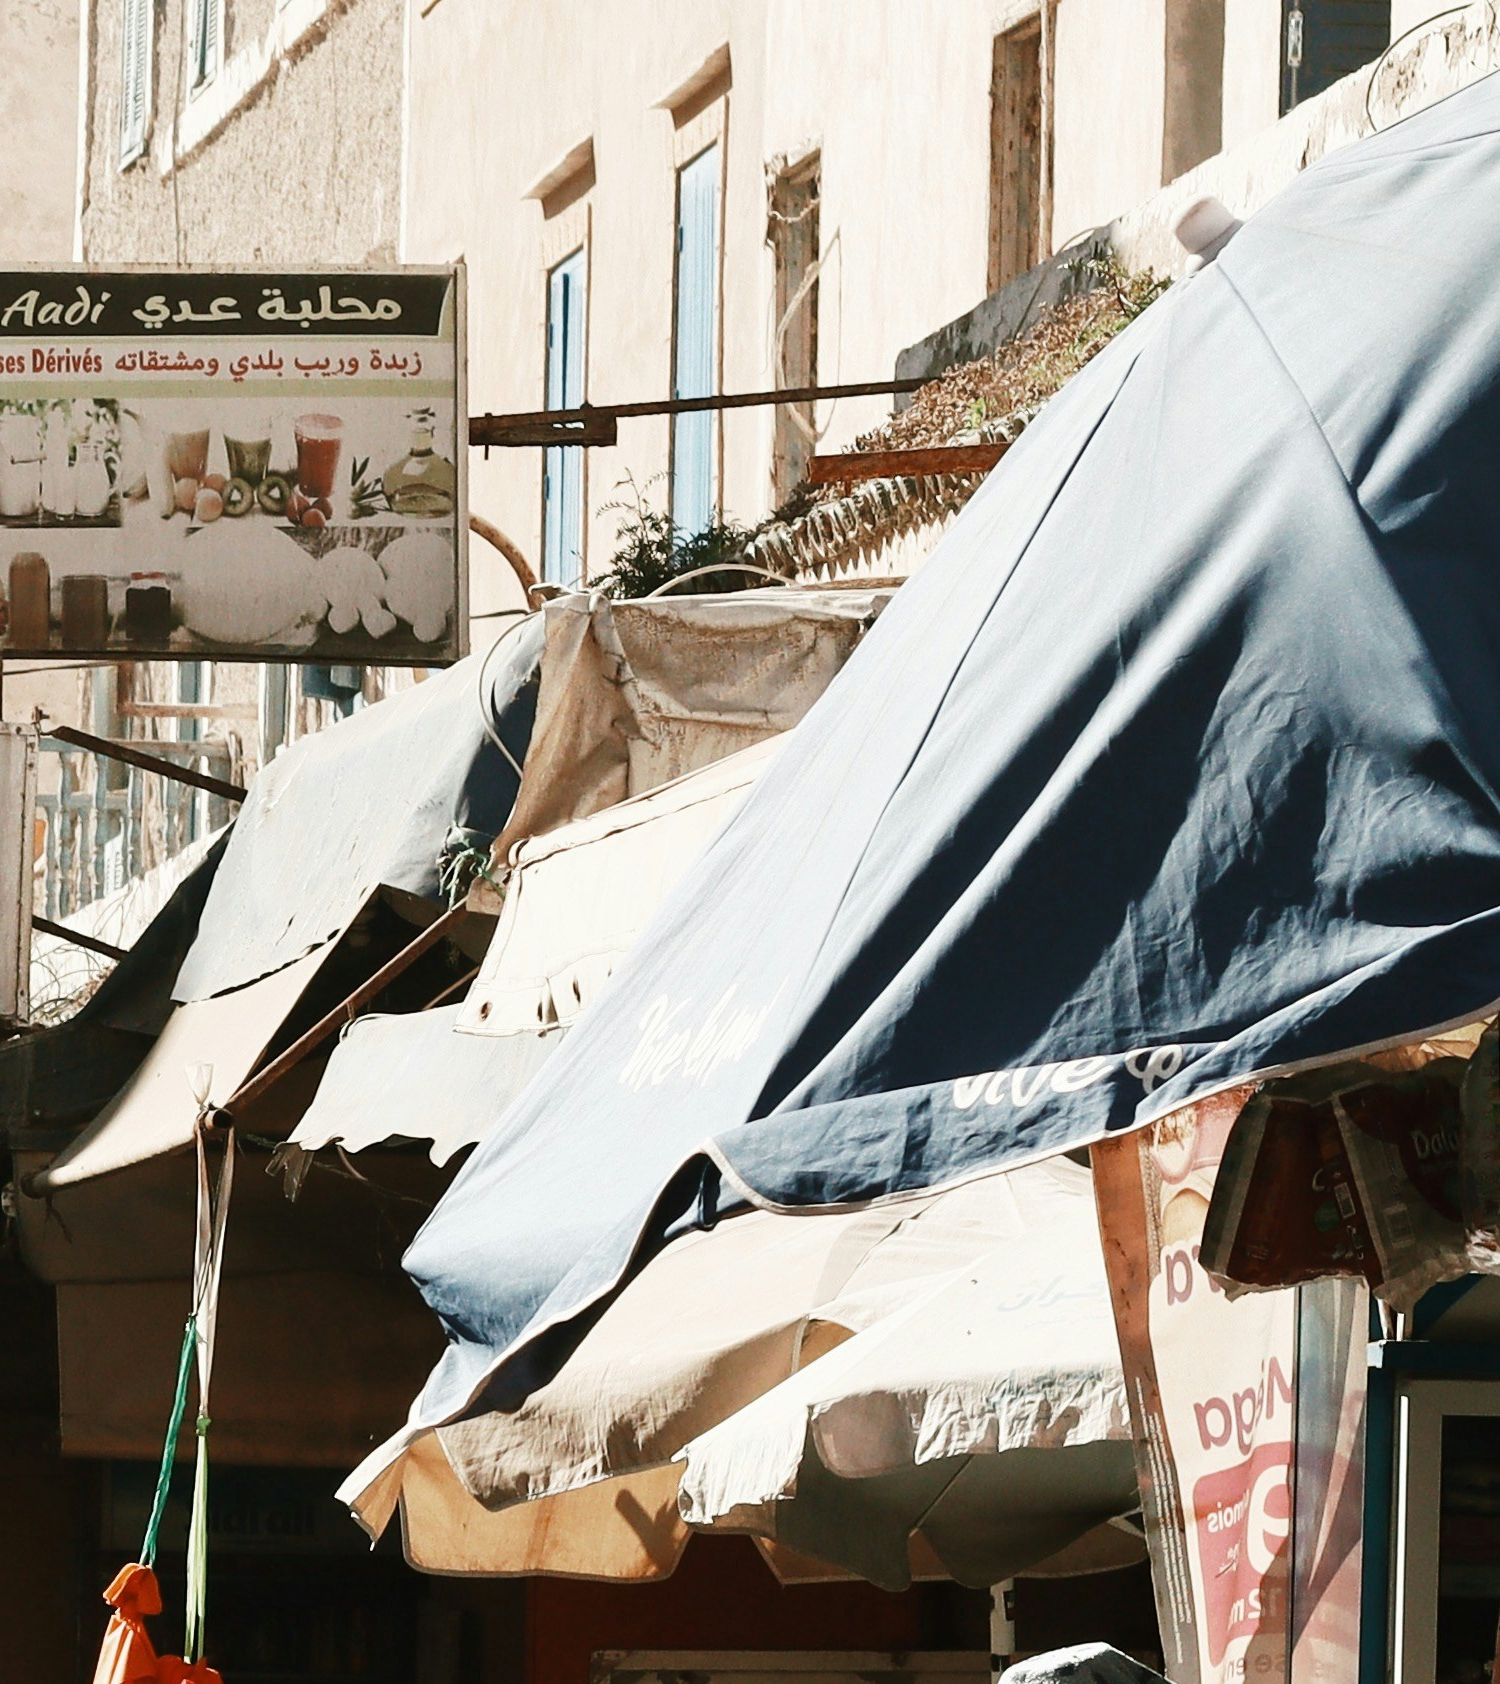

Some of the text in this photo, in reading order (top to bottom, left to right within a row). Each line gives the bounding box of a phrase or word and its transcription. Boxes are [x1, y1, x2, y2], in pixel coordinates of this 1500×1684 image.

[0, 285, 112, 328] Aadi
[131, 285, 402, 329] محلبة عدي
[31, 347, 103, 374] Dérivés
[114, 348, 422, 383] زبدة وريب بلدي ومشتقاته
